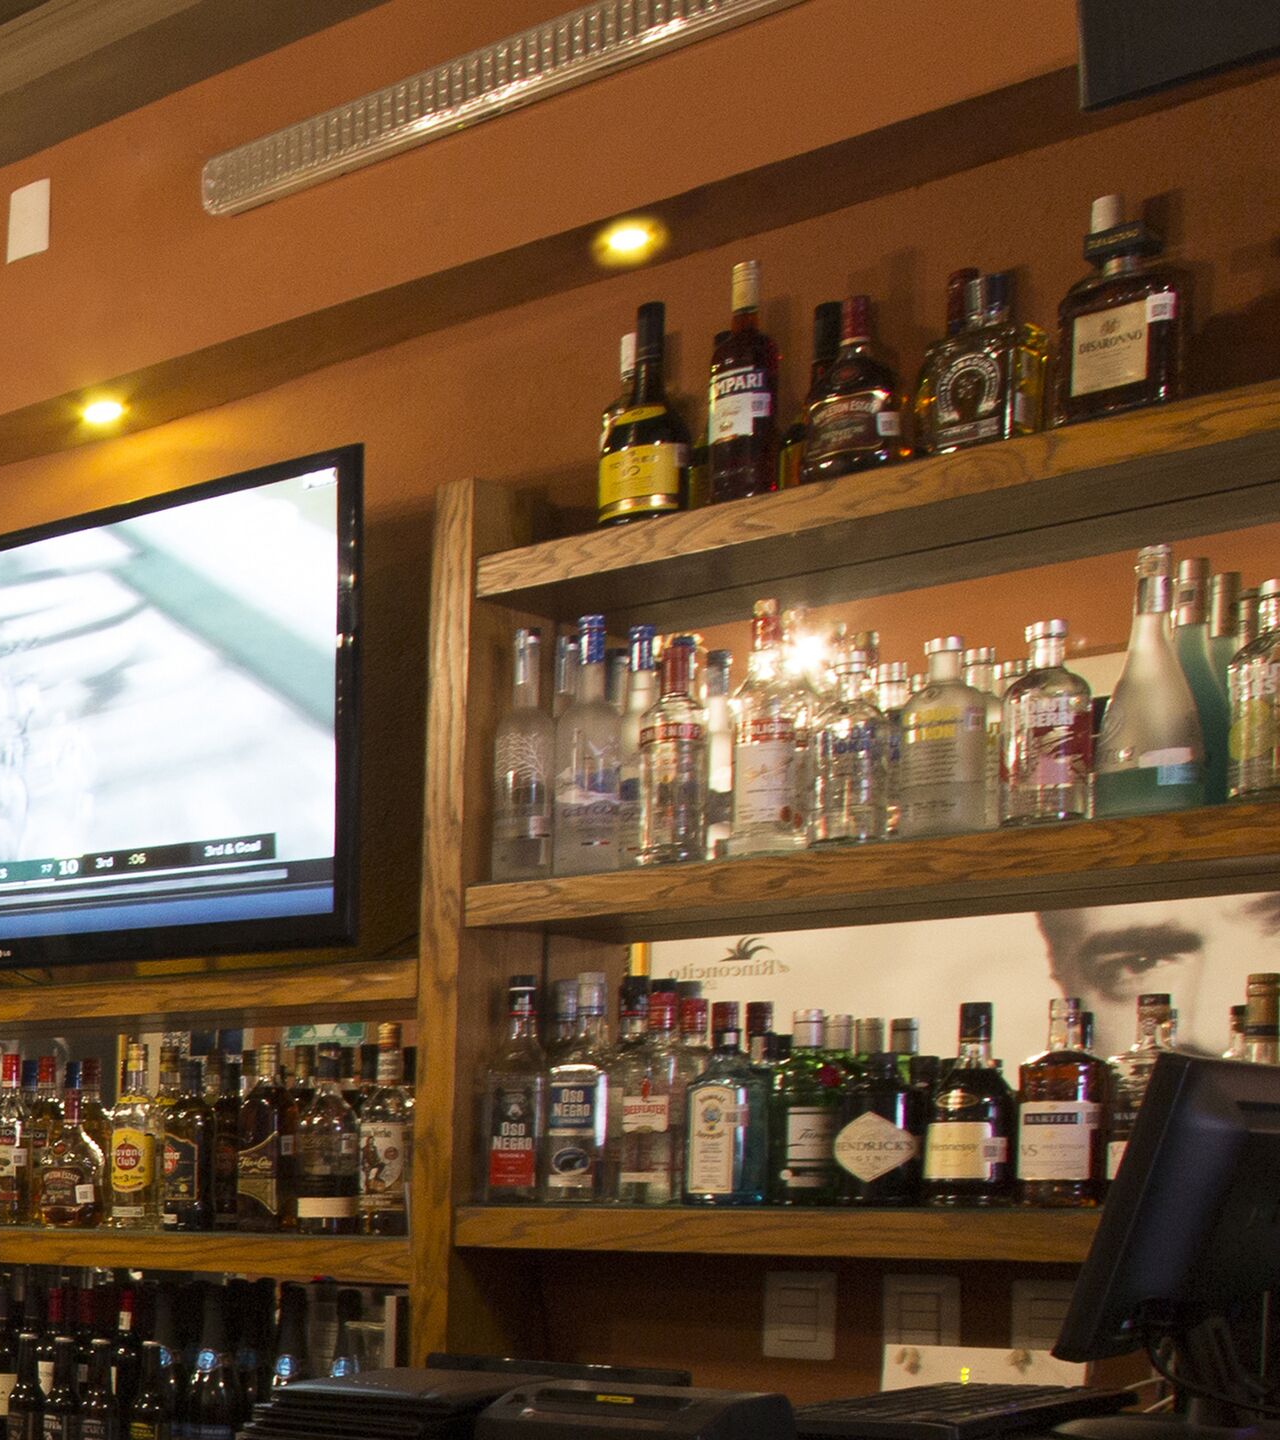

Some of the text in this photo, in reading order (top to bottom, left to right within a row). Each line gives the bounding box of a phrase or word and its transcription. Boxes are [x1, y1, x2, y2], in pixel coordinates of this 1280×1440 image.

[1078, 328, 1144, 355] DISARONNO
[58, 859, 80, 876] 10
[95, 856, 114, 869] 3rd
[127, 852, 147, 865] :06
[204, 844, 224, 858] 3rd
[224, 843, 235, 855] &
[235, 840, 262, 854] Goal
[563, 1088, 584, 1104] OSO
[554, 1102, 591, 1117] NEGRO
[623, 1103, 668, 1116] BEEFEATER
[1026, 1113, 1078, 1124] MARTELL
[500, 1120, 526, 1137] OSO
[492, 1135, 533, 1151] NEGRO
[117, 1157, 137, 1166] Club
